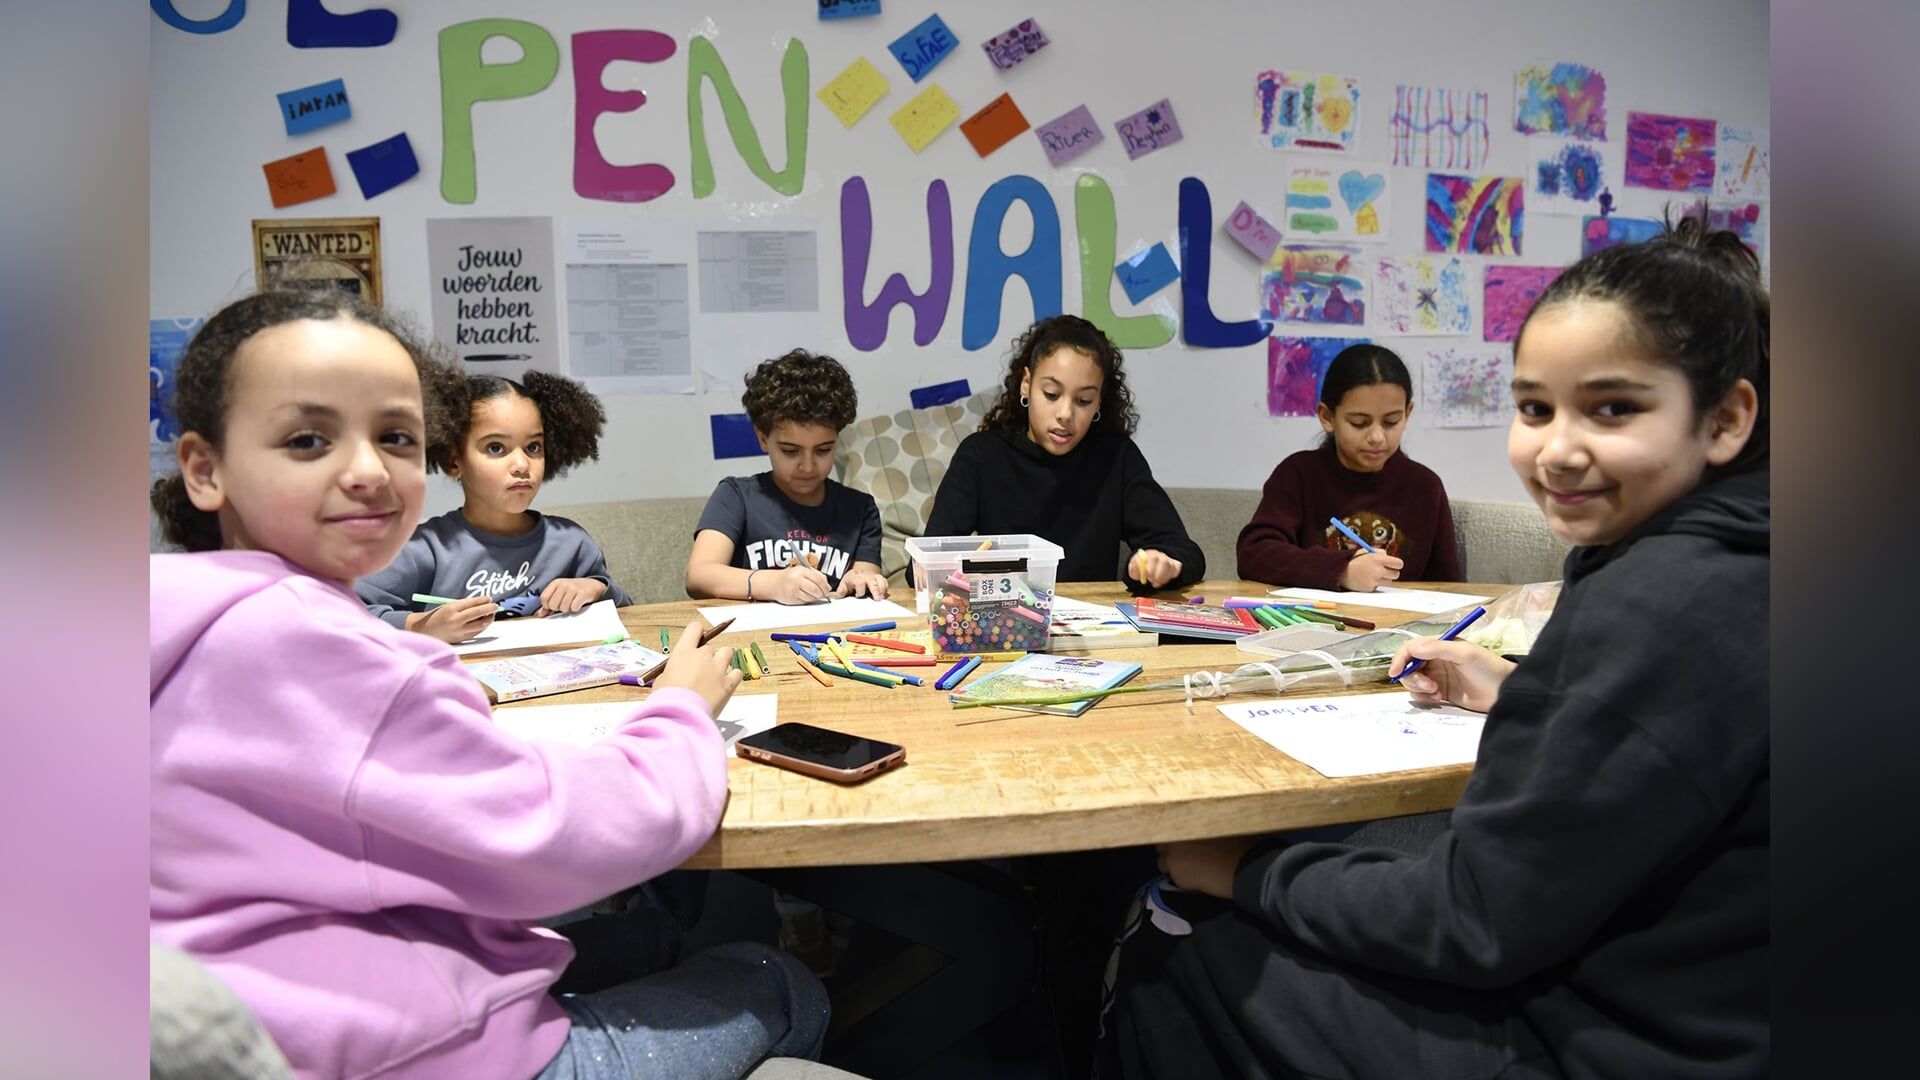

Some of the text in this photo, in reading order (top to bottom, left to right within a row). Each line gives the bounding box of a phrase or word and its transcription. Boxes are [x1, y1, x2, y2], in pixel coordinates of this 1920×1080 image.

[438, 18, 810, 205] PEN
[272, 232, 363, 254] WANTED
[458, 245, 523, 272] Jouw
[840, 172, 1274, 352] WALL
[443, 270, 543, 294] woorden
[458, 297, 534, 320] hebben
[456, 322, 540, 345] kracht.
[465, 561, 536, 599] Stitch
[999, 578, 1012, 593] 3
